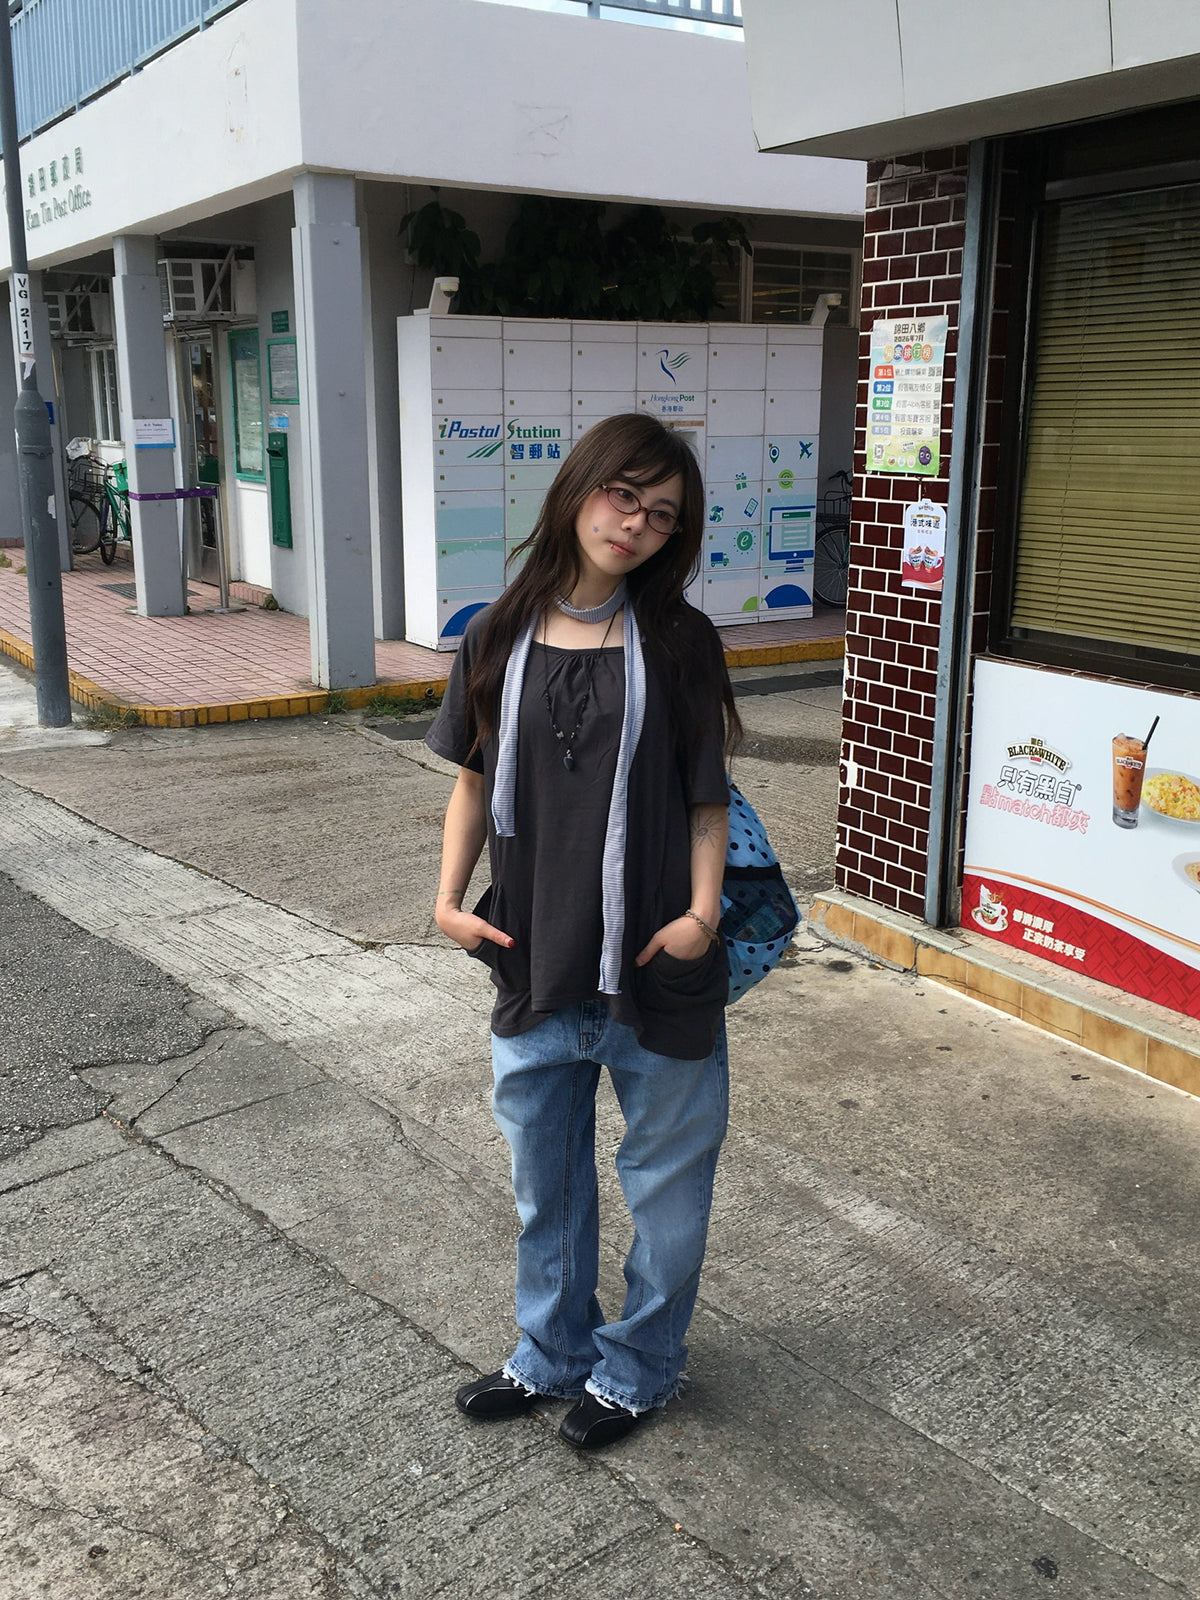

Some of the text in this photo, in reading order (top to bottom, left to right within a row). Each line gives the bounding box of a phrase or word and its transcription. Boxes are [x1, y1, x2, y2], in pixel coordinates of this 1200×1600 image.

[40, 202, 53, 224] Tin
[53, 197, 68, 219] Post
[68, 184, 91, 212] Office
[18, 278, 32, 350] VG 2117
[680, 394, 695, 402] Post
[440, 418, 561, 440] iPostal Station
[510, 443, 561, 460] 智郵站
[1022, 927, 1086, 962] 正宗奶茶享受
